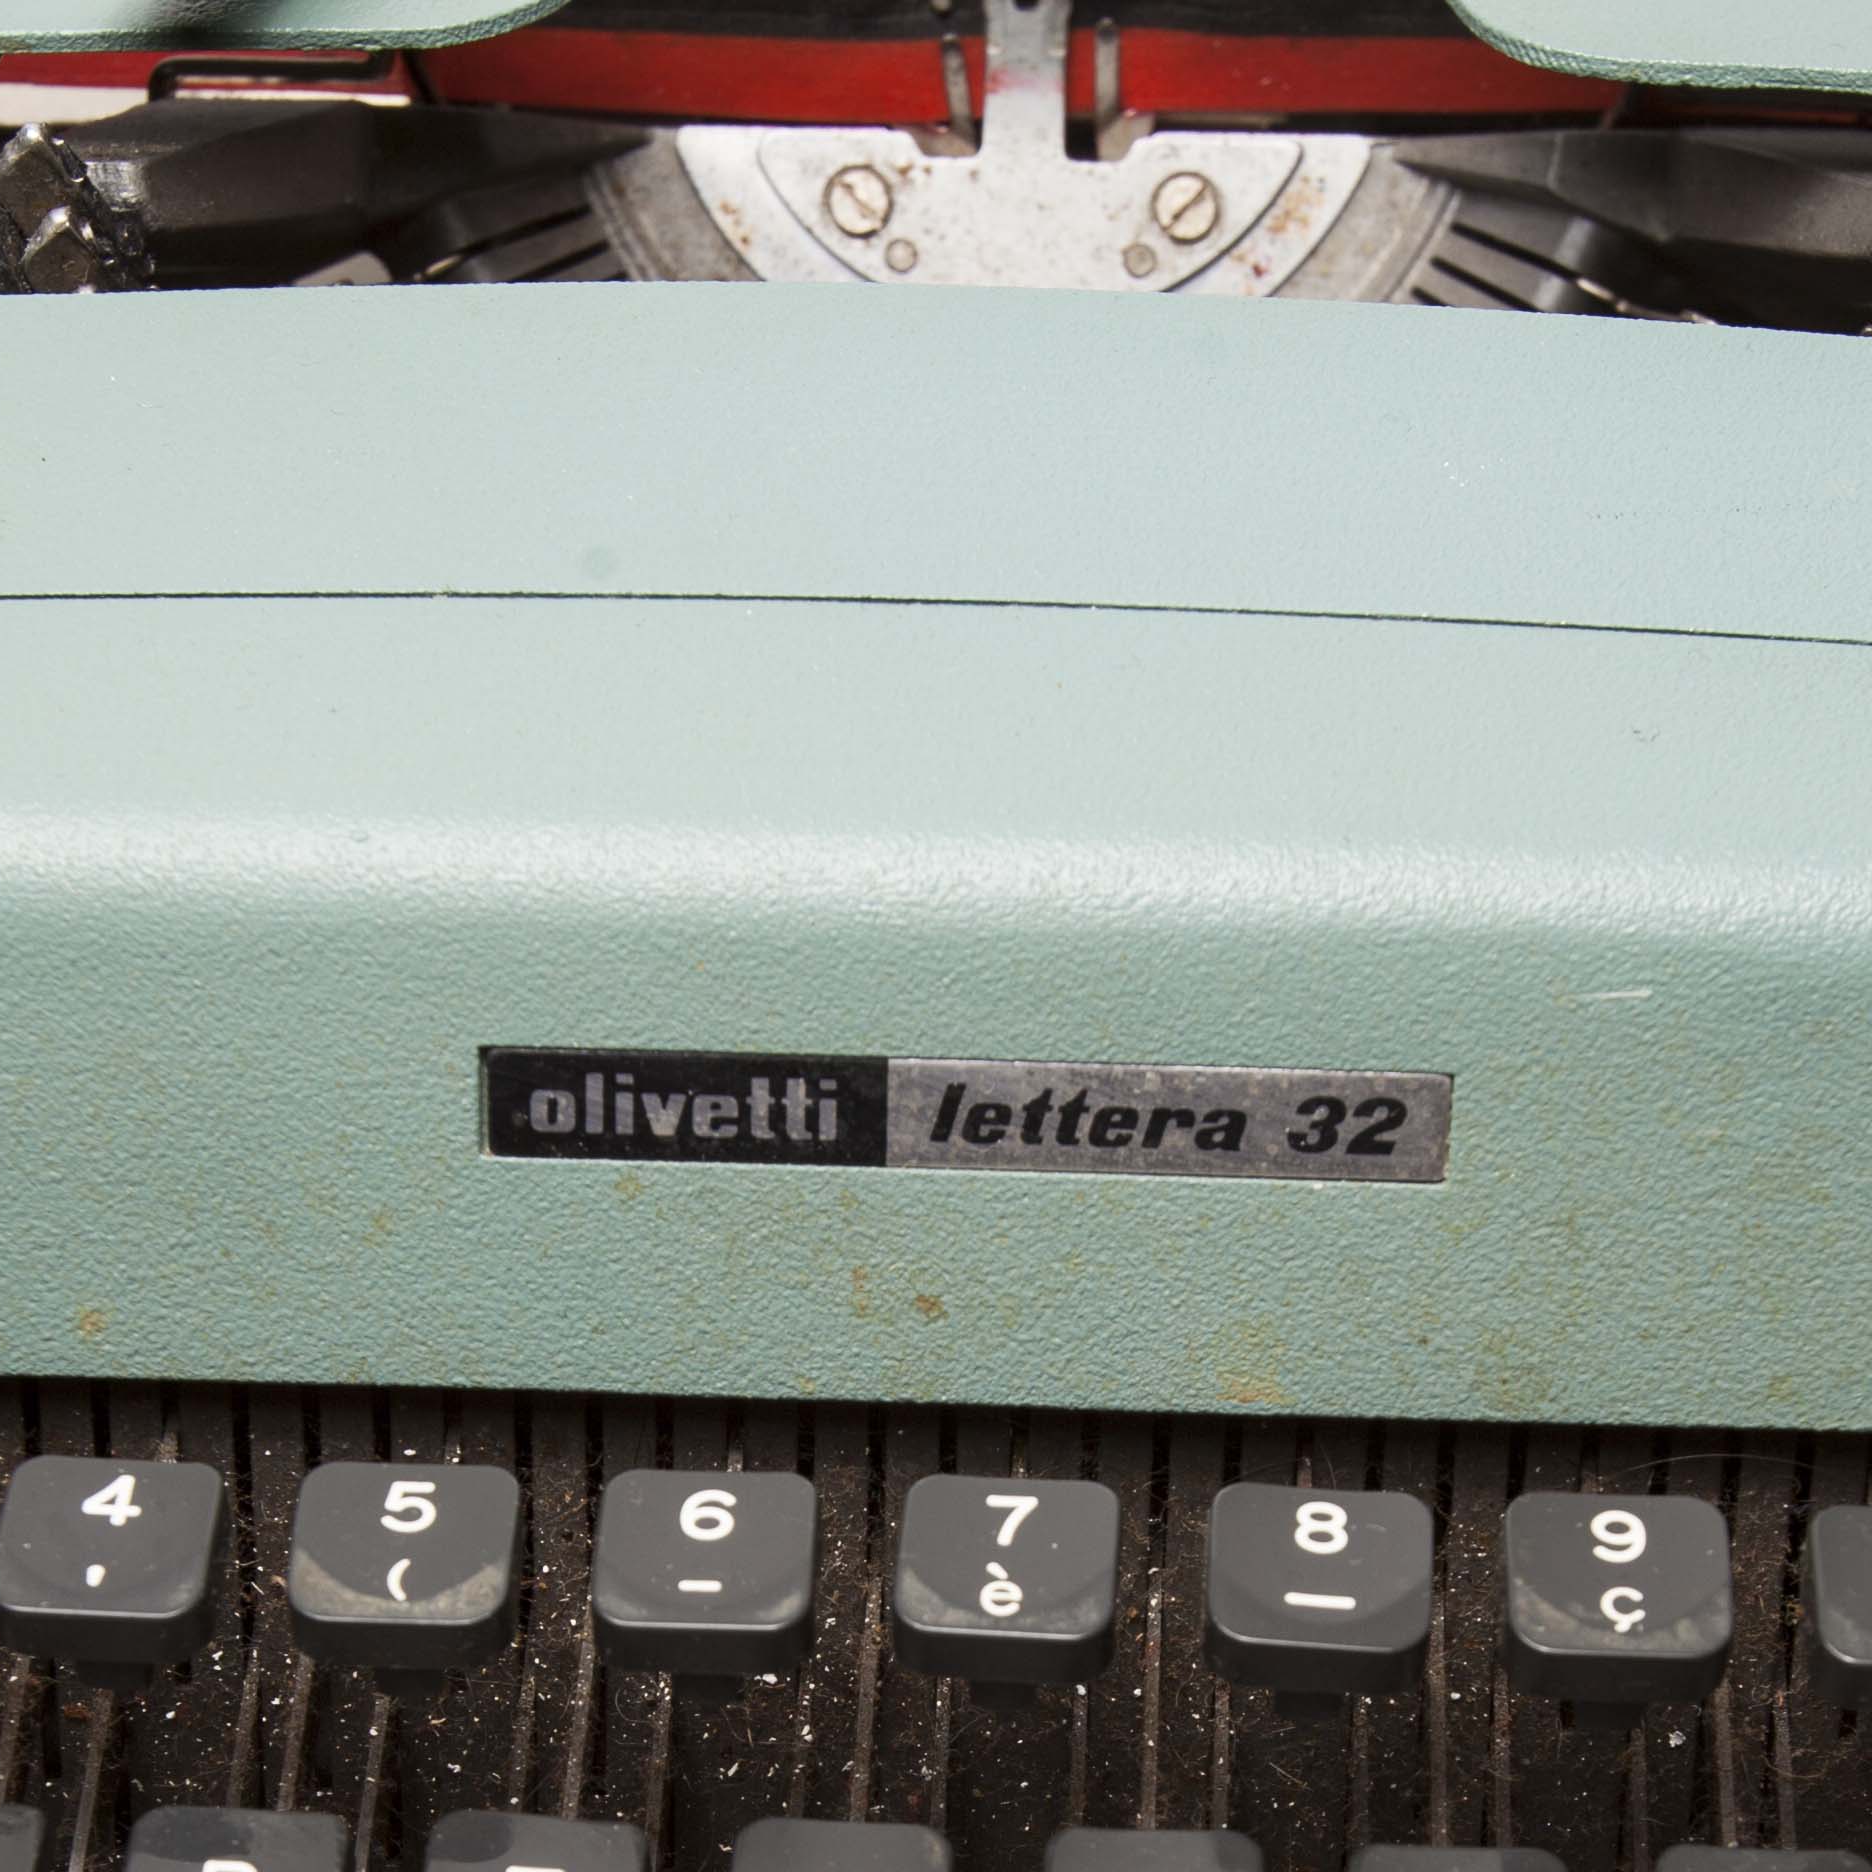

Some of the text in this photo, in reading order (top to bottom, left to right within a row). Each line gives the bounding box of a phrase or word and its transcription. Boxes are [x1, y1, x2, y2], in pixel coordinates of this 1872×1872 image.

[529, 1071, 839, 1142] olivetti
[929, 1082, 1409, 1156] lettera 32
[81, 1474, 142, 1527] 4
[380, 1480, 437, 1534] 5
[679, 1489, 737, 1541] 6
[985, 1494, 1039, 1547] 7
[1294, 1501, 1349, 1555] 8
[1590, 1509, 1647, 1564] 9
[979, 1561, 1023, 1617] è
[1600, 1586, 1646, 1633] ç
